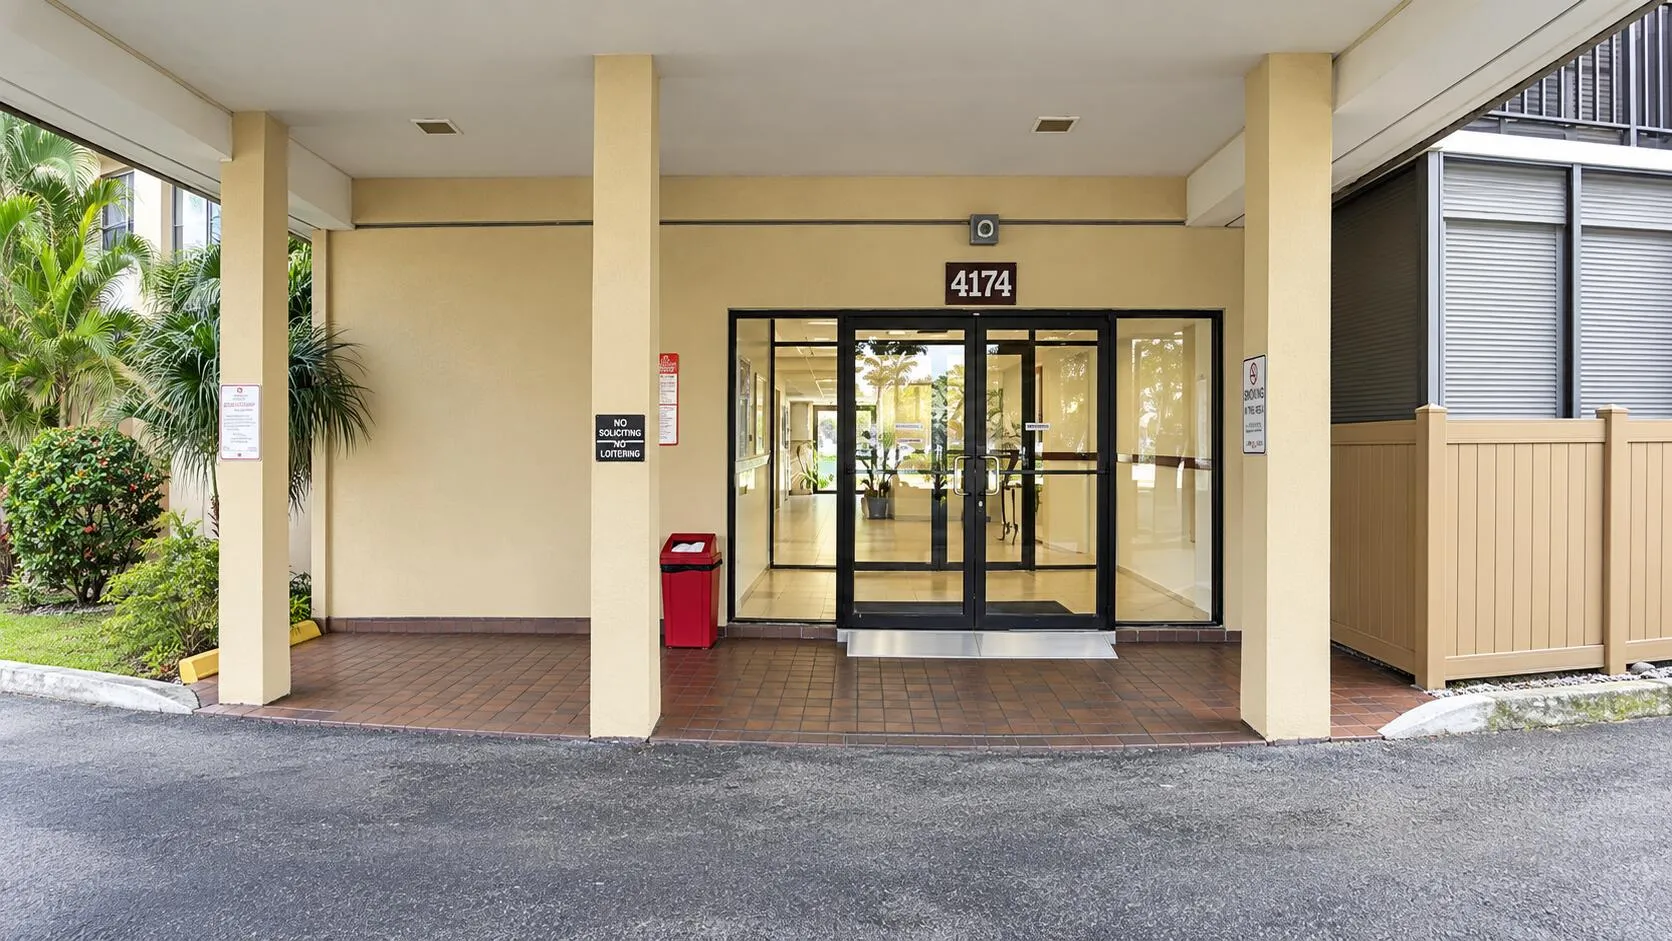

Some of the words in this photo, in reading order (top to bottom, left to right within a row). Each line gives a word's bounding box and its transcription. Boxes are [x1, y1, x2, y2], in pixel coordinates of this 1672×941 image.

[950, 270, 1012, 297] 4174
[613, 418, 628, 427] NO
[598, 429, 642, 437] SOLICITING
[613, 440, 626, 448] NO
[600, 449, 641, 458] LOITERING
